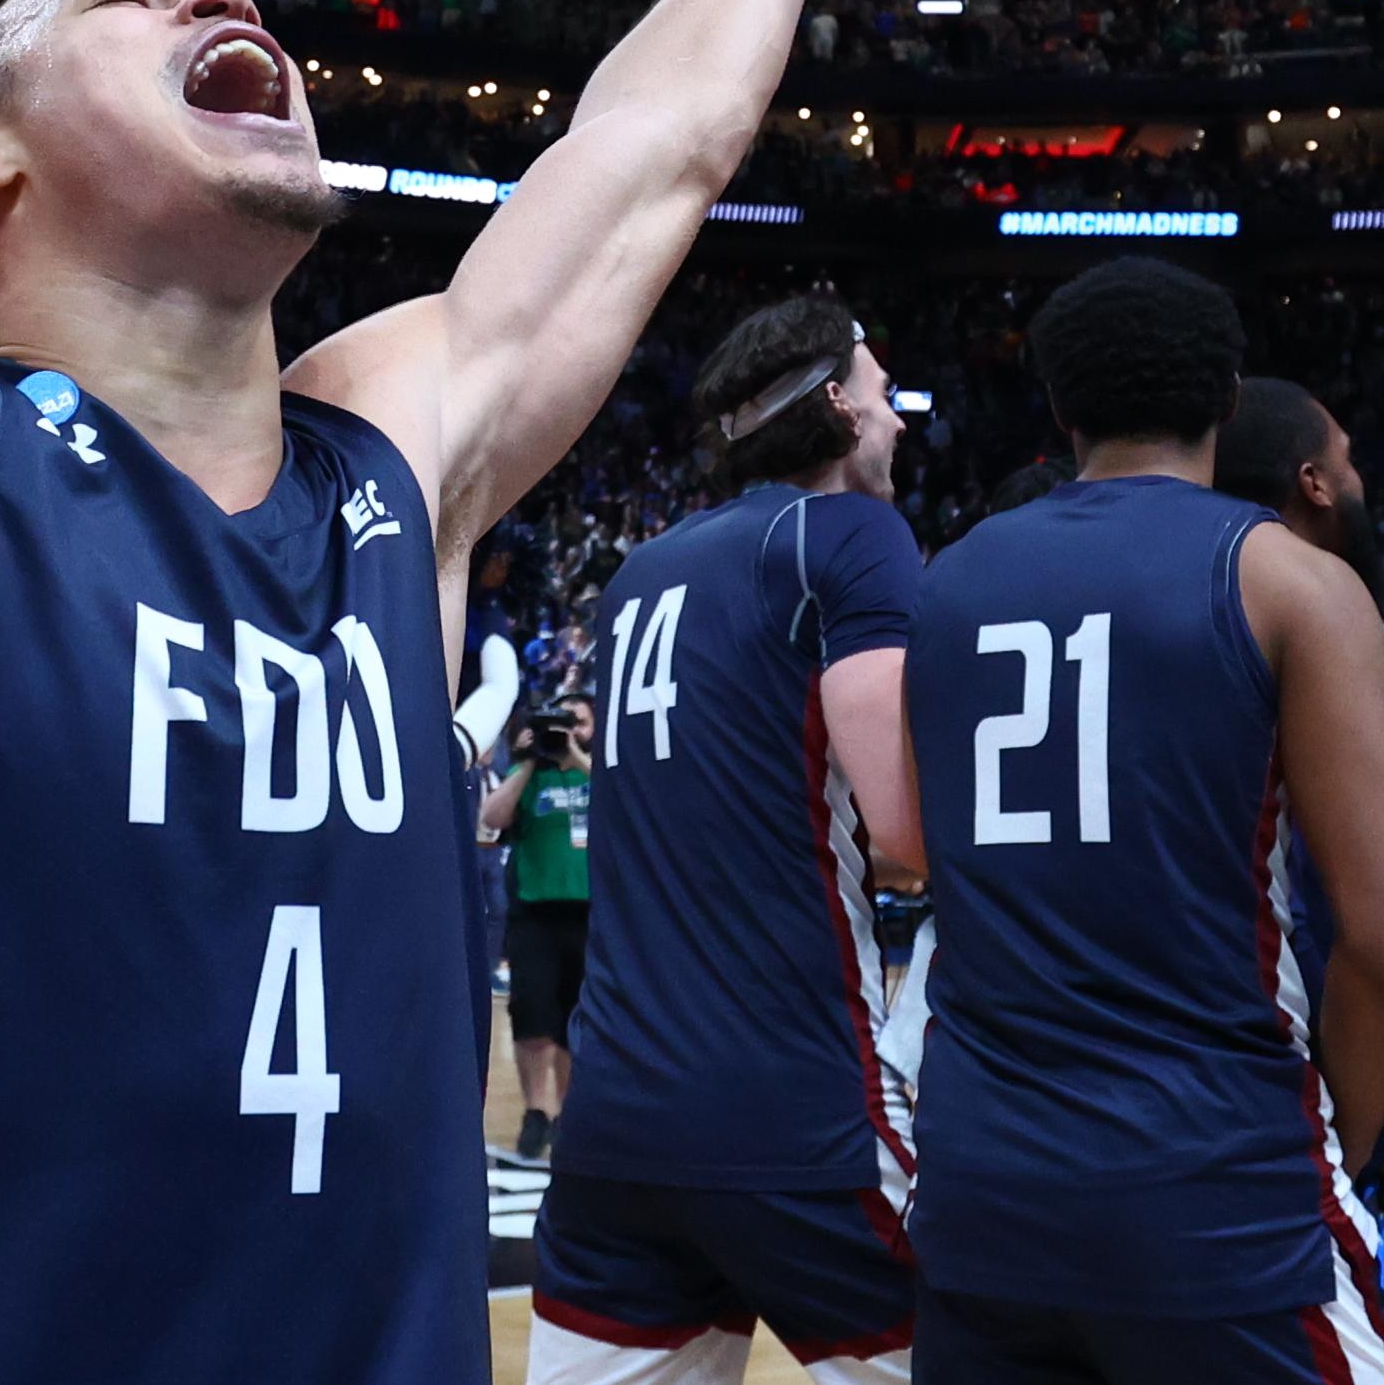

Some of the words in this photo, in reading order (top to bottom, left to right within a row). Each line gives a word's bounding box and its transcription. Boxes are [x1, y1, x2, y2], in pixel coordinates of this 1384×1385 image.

[999, 212, 1239, 237] #MARCHMADNESS
[128, 601, 404, 834] FDU
[605, 584, 687, 768] 14
[974, 612, 1111, 845] 21
[239, 905, 340, 1194] 4
